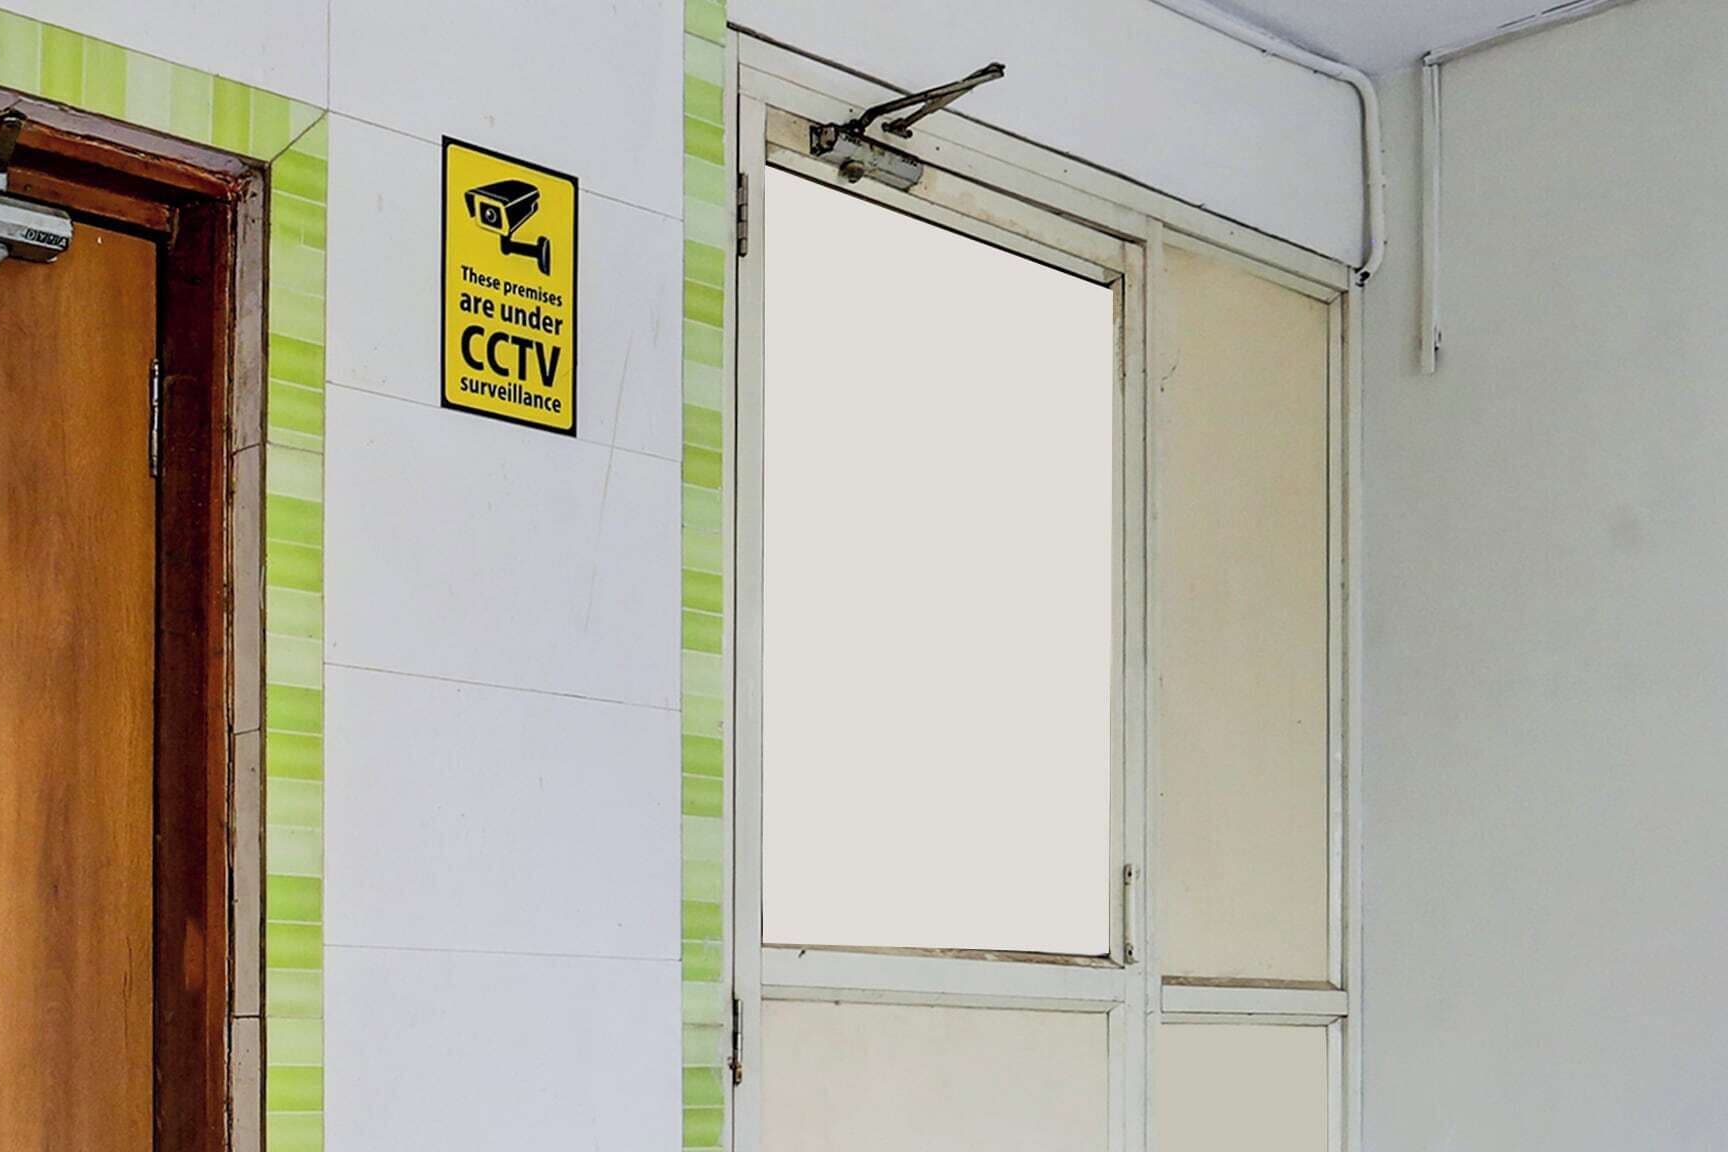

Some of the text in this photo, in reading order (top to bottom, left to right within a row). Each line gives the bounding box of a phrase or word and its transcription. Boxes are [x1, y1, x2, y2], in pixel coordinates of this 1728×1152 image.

[462, 265, 562, 307] These premises
[460, 292, 562, 335] are under
[461, 325, 561, 387] CCTV
[461, 377, 561, 413] surveillance
